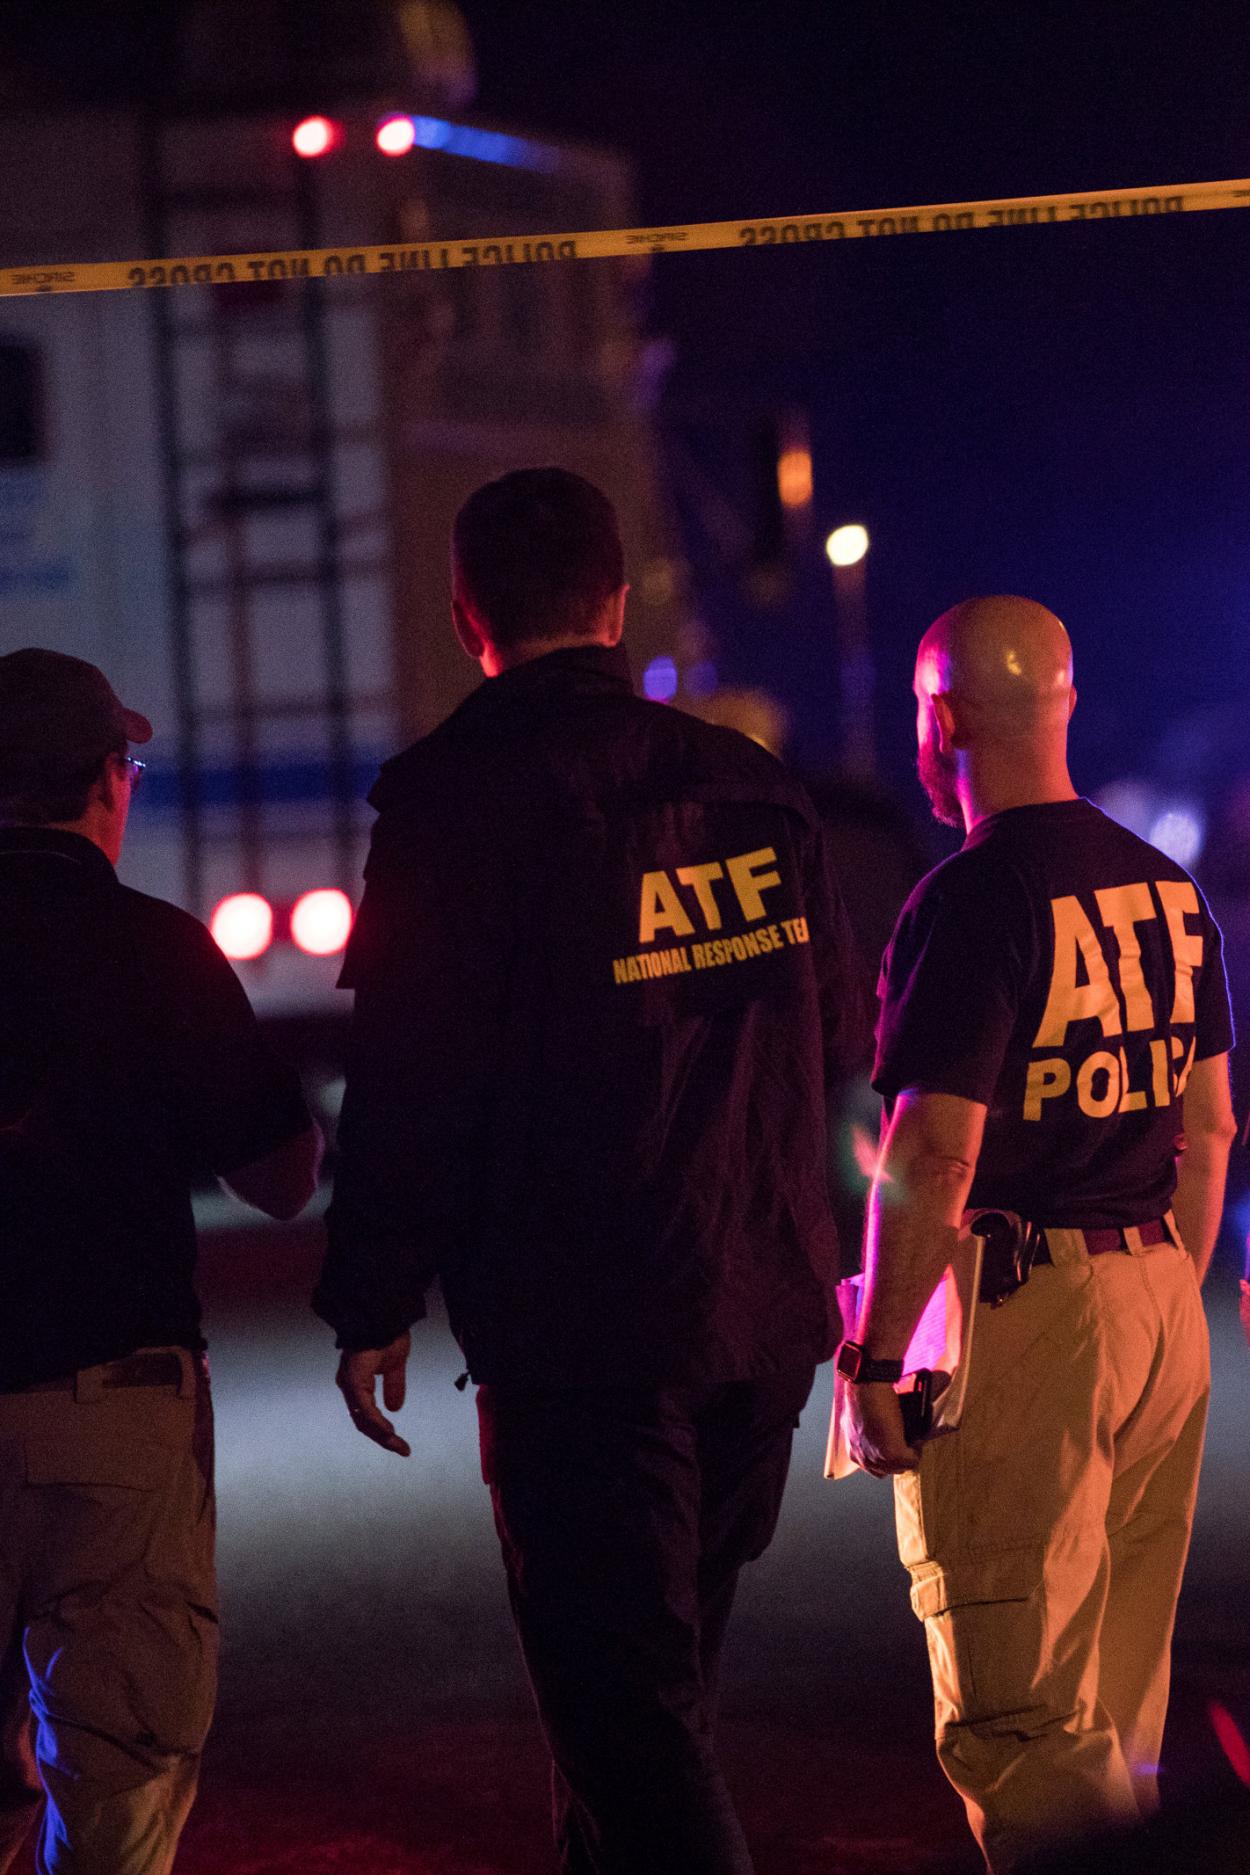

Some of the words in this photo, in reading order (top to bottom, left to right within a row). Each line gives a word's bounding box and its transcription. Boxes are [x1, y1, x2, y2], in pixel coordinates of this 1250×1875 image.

[639, 847, 781, 944] ATF
[613, 947, 692, 984] NATIONAL
[692, 924, 783, 971] RESPONSE
[1031, 880, 1203, 1048] ATF
